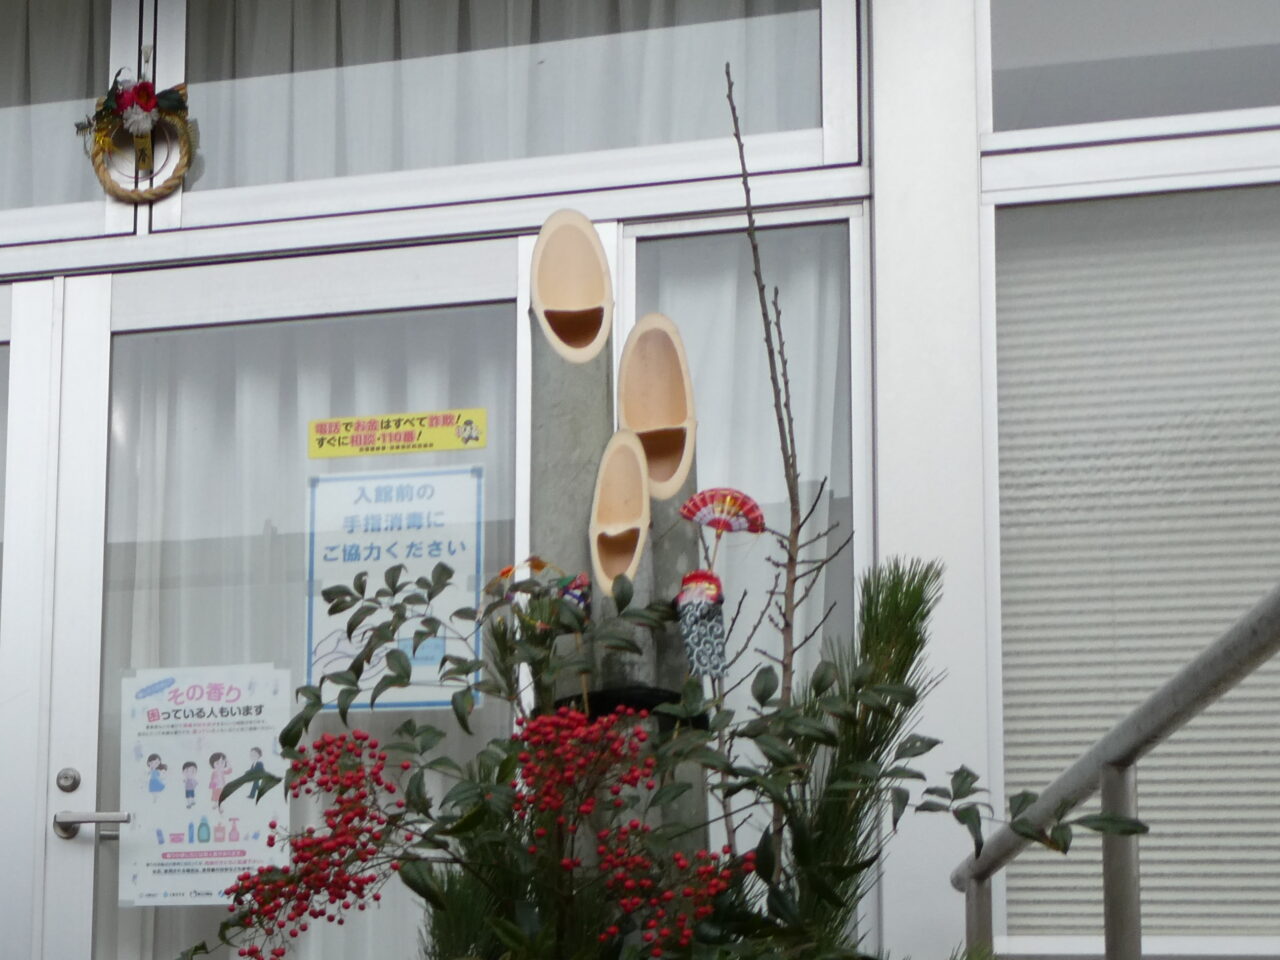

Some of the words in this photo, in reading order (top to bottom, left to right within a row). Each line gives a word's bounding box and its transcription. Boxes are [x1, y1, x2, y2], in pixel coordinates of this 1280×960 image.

[353, 483, 435, 504] 入館前の
[343, 511, 445, 534] 手指消毒に
[322, 540, 467, 562] ご協力ください
[168, 682, 241, 705] その香り
